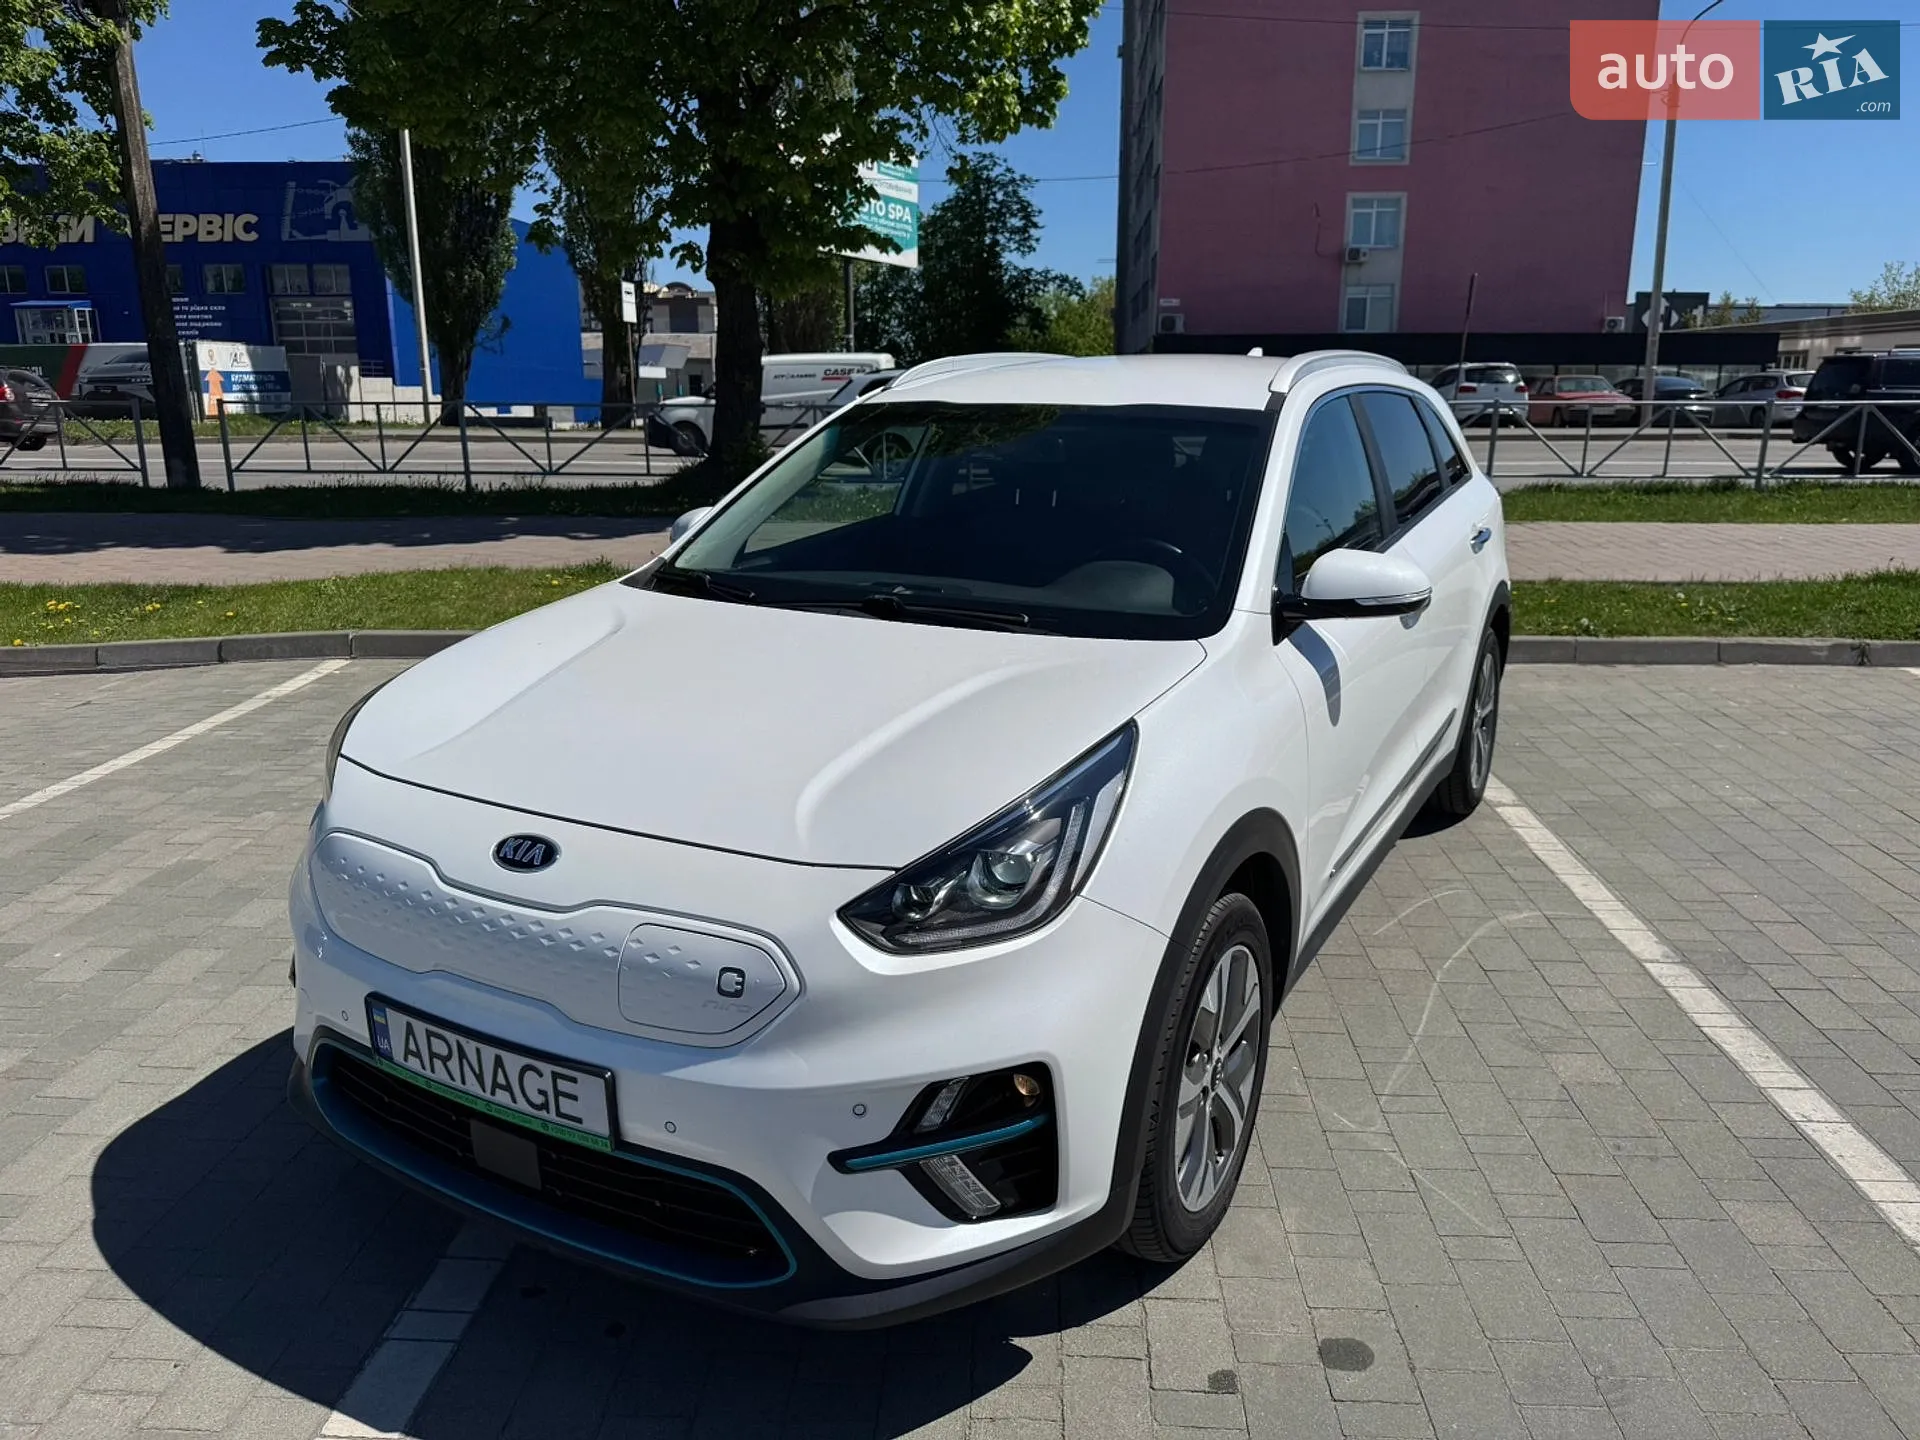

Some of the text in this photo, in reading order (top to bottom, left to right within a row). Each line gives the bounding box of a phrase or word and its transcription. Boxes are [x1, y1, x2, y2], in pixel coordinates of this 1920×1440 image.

[888, 203, 912, 223] SPA
[156, 213, 259, 242] ЕРВІС
[499, 838, 546, 865] KIA
[377, 1034, 391, 1050] UA
[403, 1020, 584, 1125] ARNAGE
